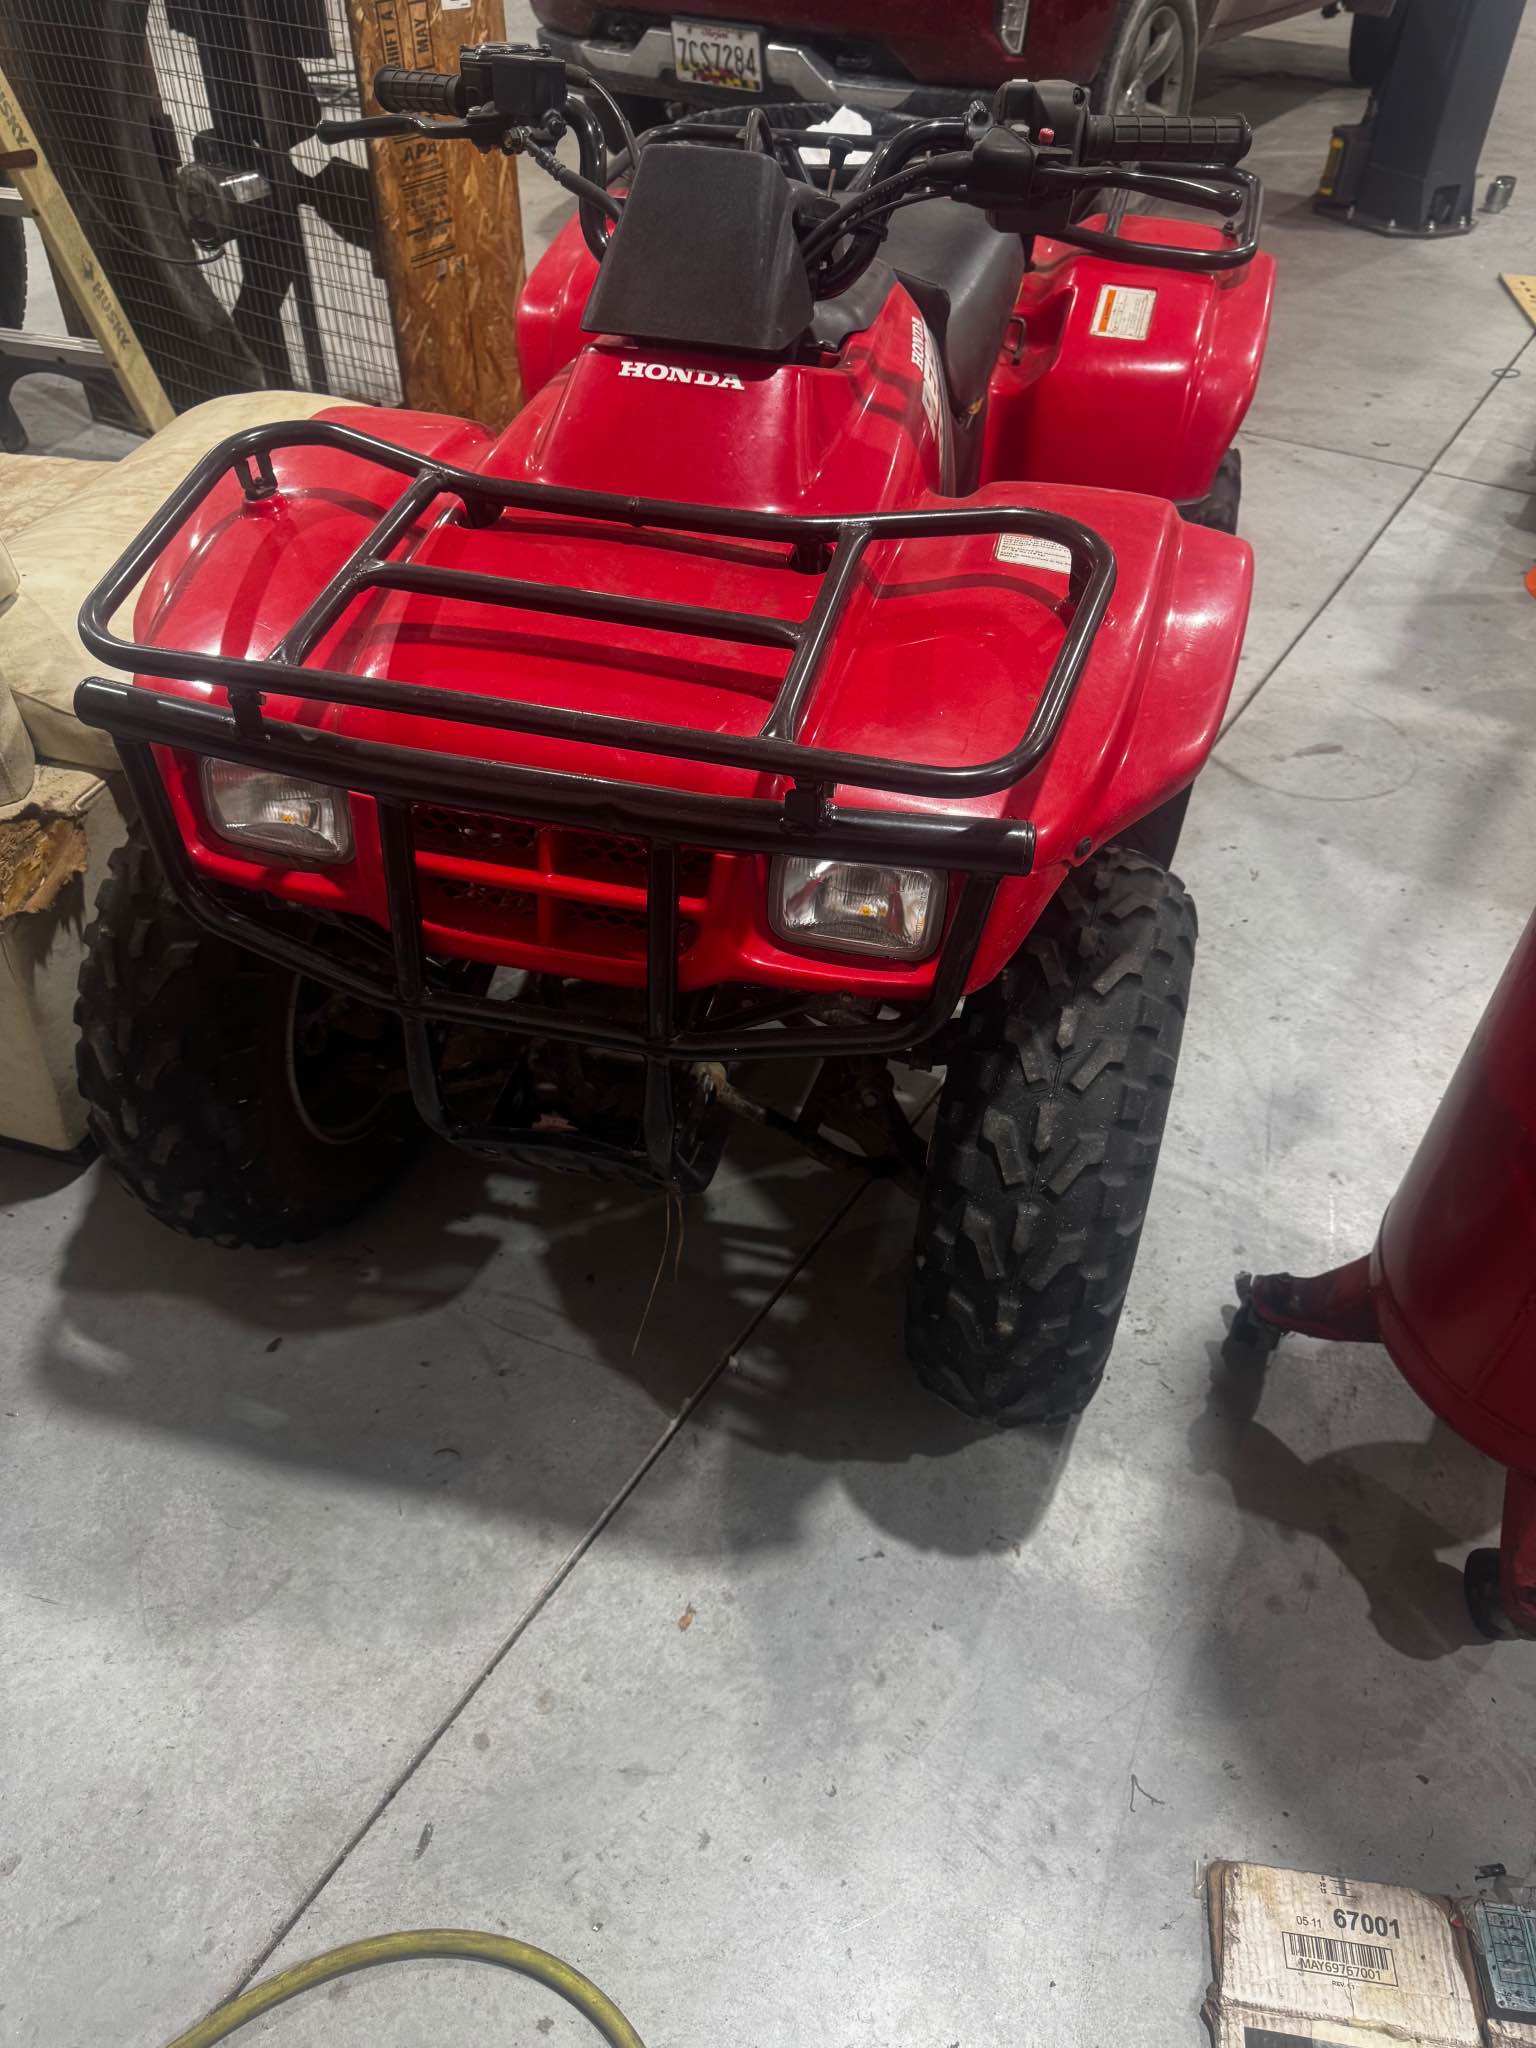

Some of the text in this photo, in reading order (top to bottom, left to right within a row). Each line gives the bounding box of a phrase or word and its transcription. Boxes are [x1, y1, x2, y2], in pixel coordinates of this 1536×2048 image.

[384, 29, 401, 67] HIFT
[414, 18, 430, 54] MAY
[618, 360, 745, 391] HONDA
[1333, 1908, 1400, 1939] 67001
[1299, 1957, 1381, 1981] MAY69767001
